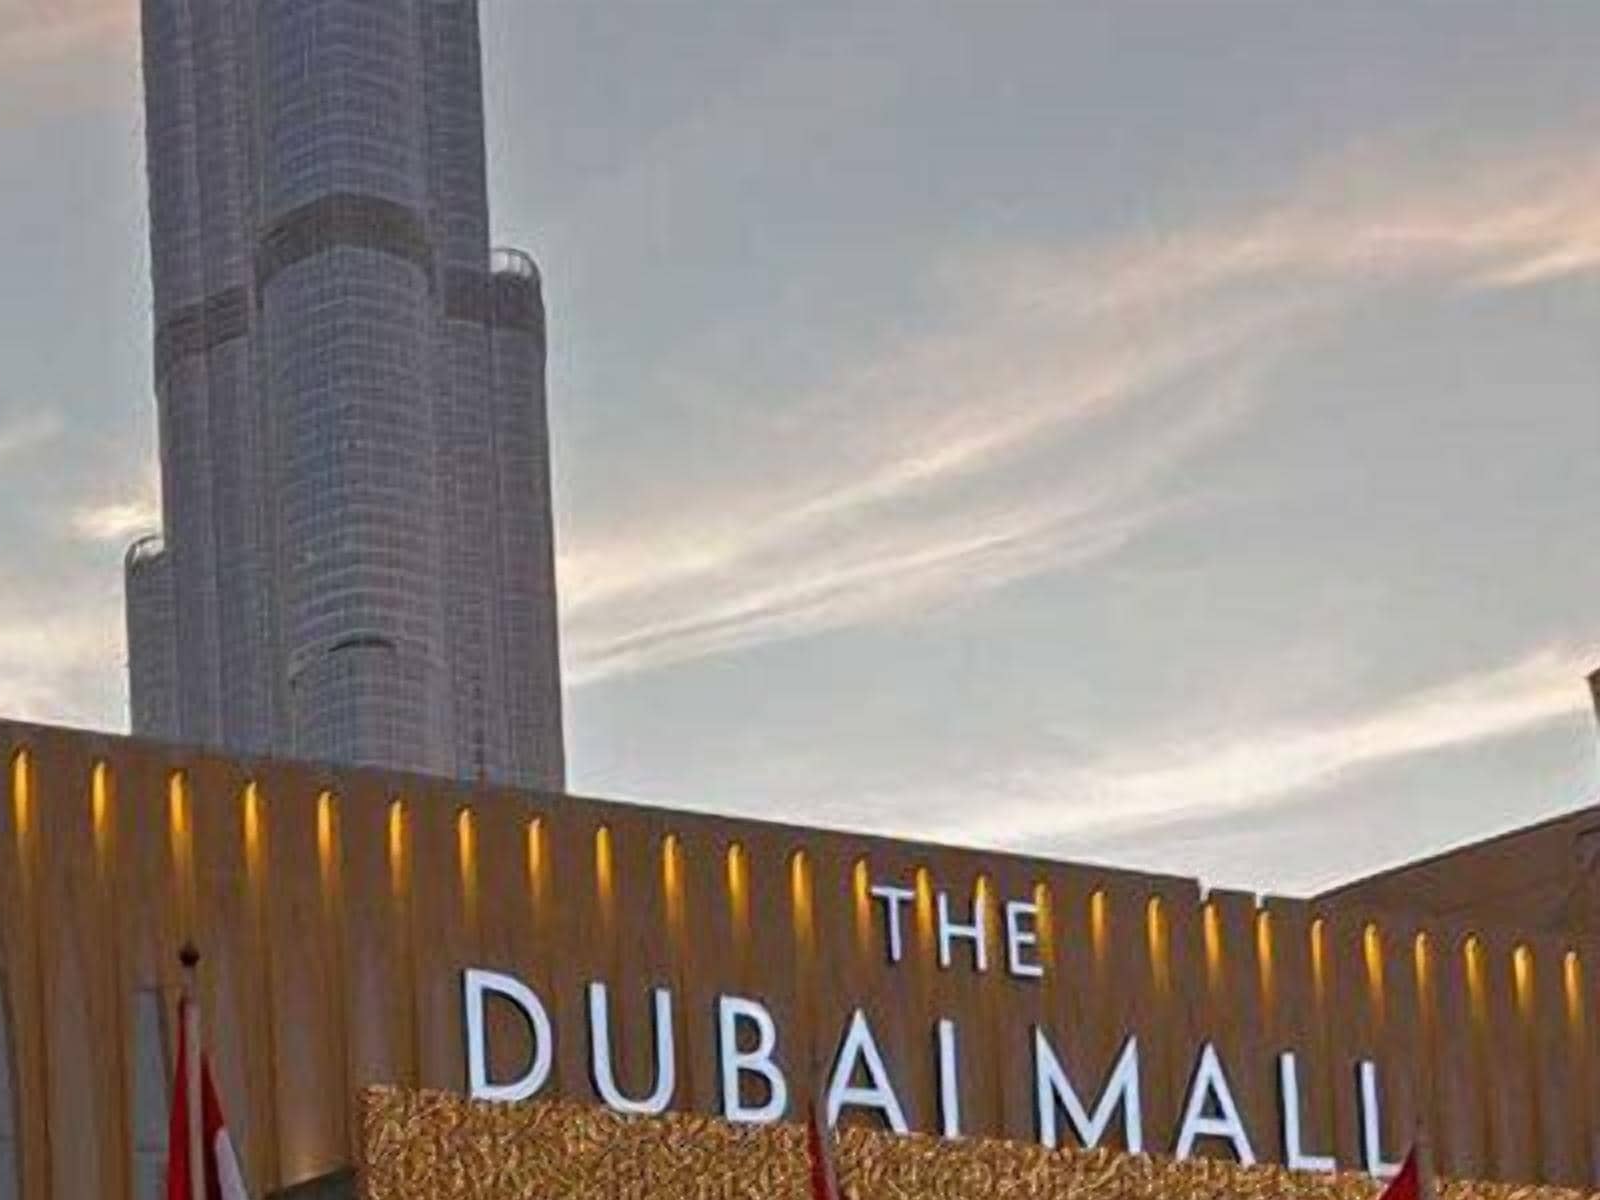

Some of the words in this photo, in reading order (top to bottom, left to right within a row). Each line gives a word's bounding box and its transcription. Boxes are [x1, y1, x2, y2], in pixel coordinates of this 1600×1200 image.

[869, 885, 1045, 976] THE
[463, 967, 961, 1139] DUBAI
[1034, 1023, 1406, 1180] MALL
